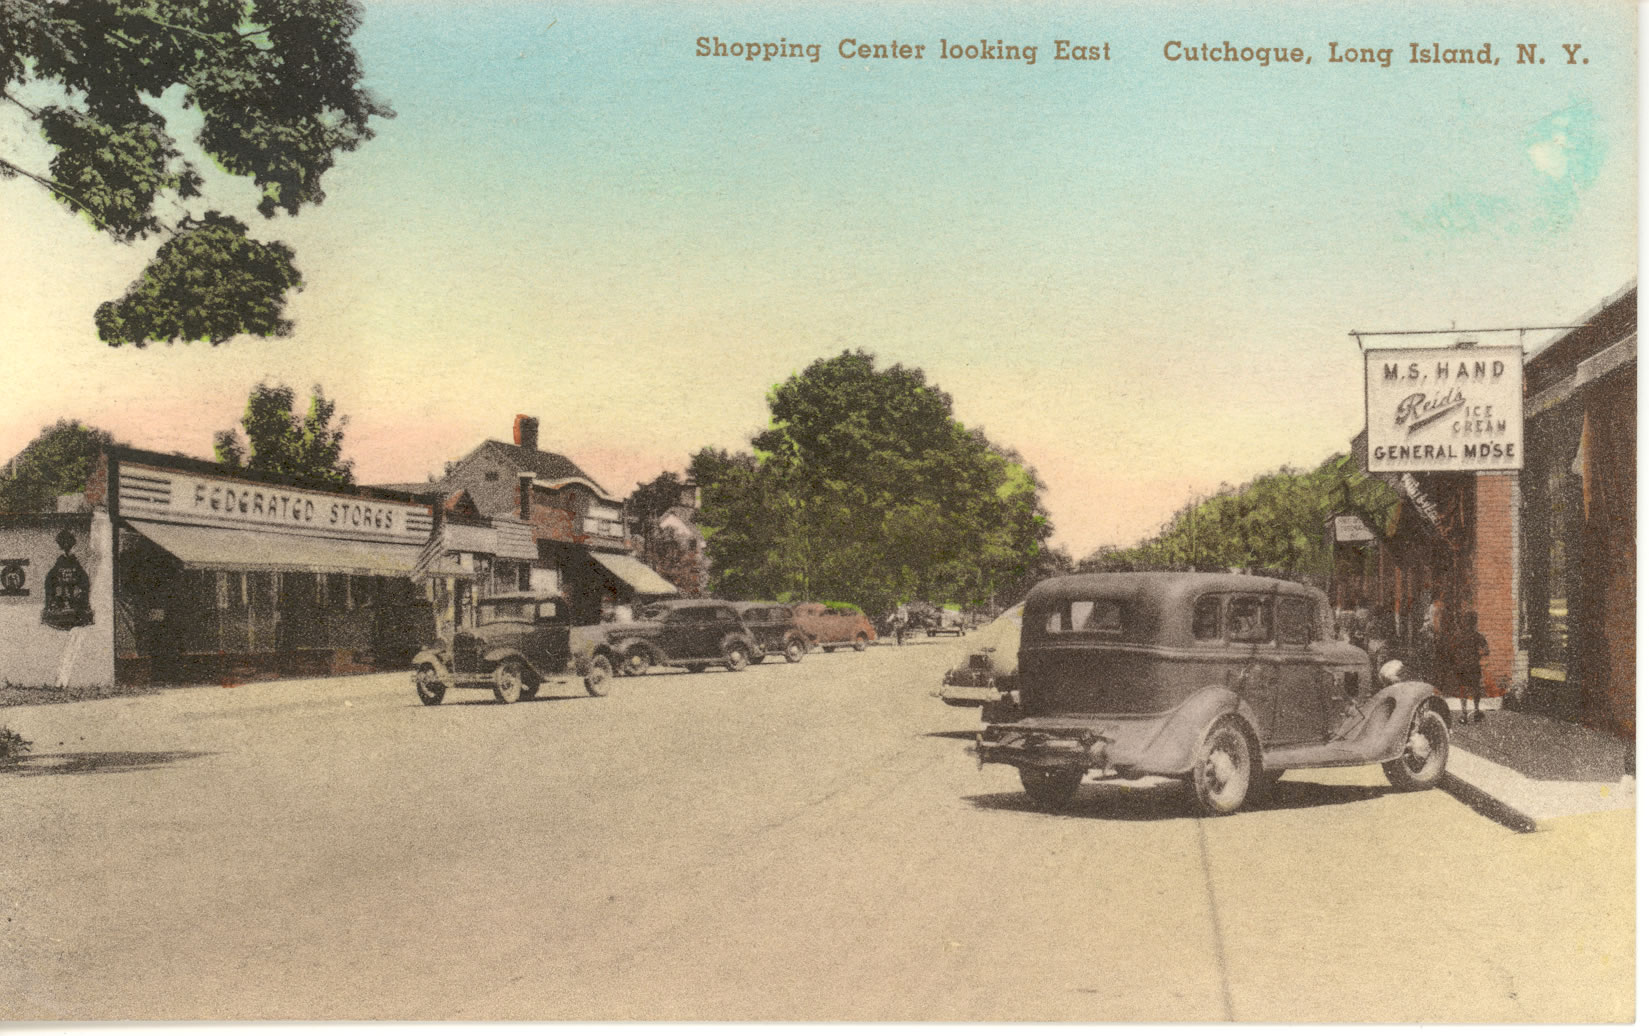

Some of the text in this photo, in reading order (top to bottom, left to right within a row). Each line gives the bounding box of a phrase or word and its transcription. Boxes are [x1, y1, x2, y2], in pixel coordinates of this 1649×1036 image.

[1437, 360, 1505, 379] HAND
[1466, 405, 1493, 418] ICE
[1452, 419, 1506, 433] CREAM
[1374, 444, 1458, 460] GENERAL
[194, 484, 393, 529] FEDERATED STORES
